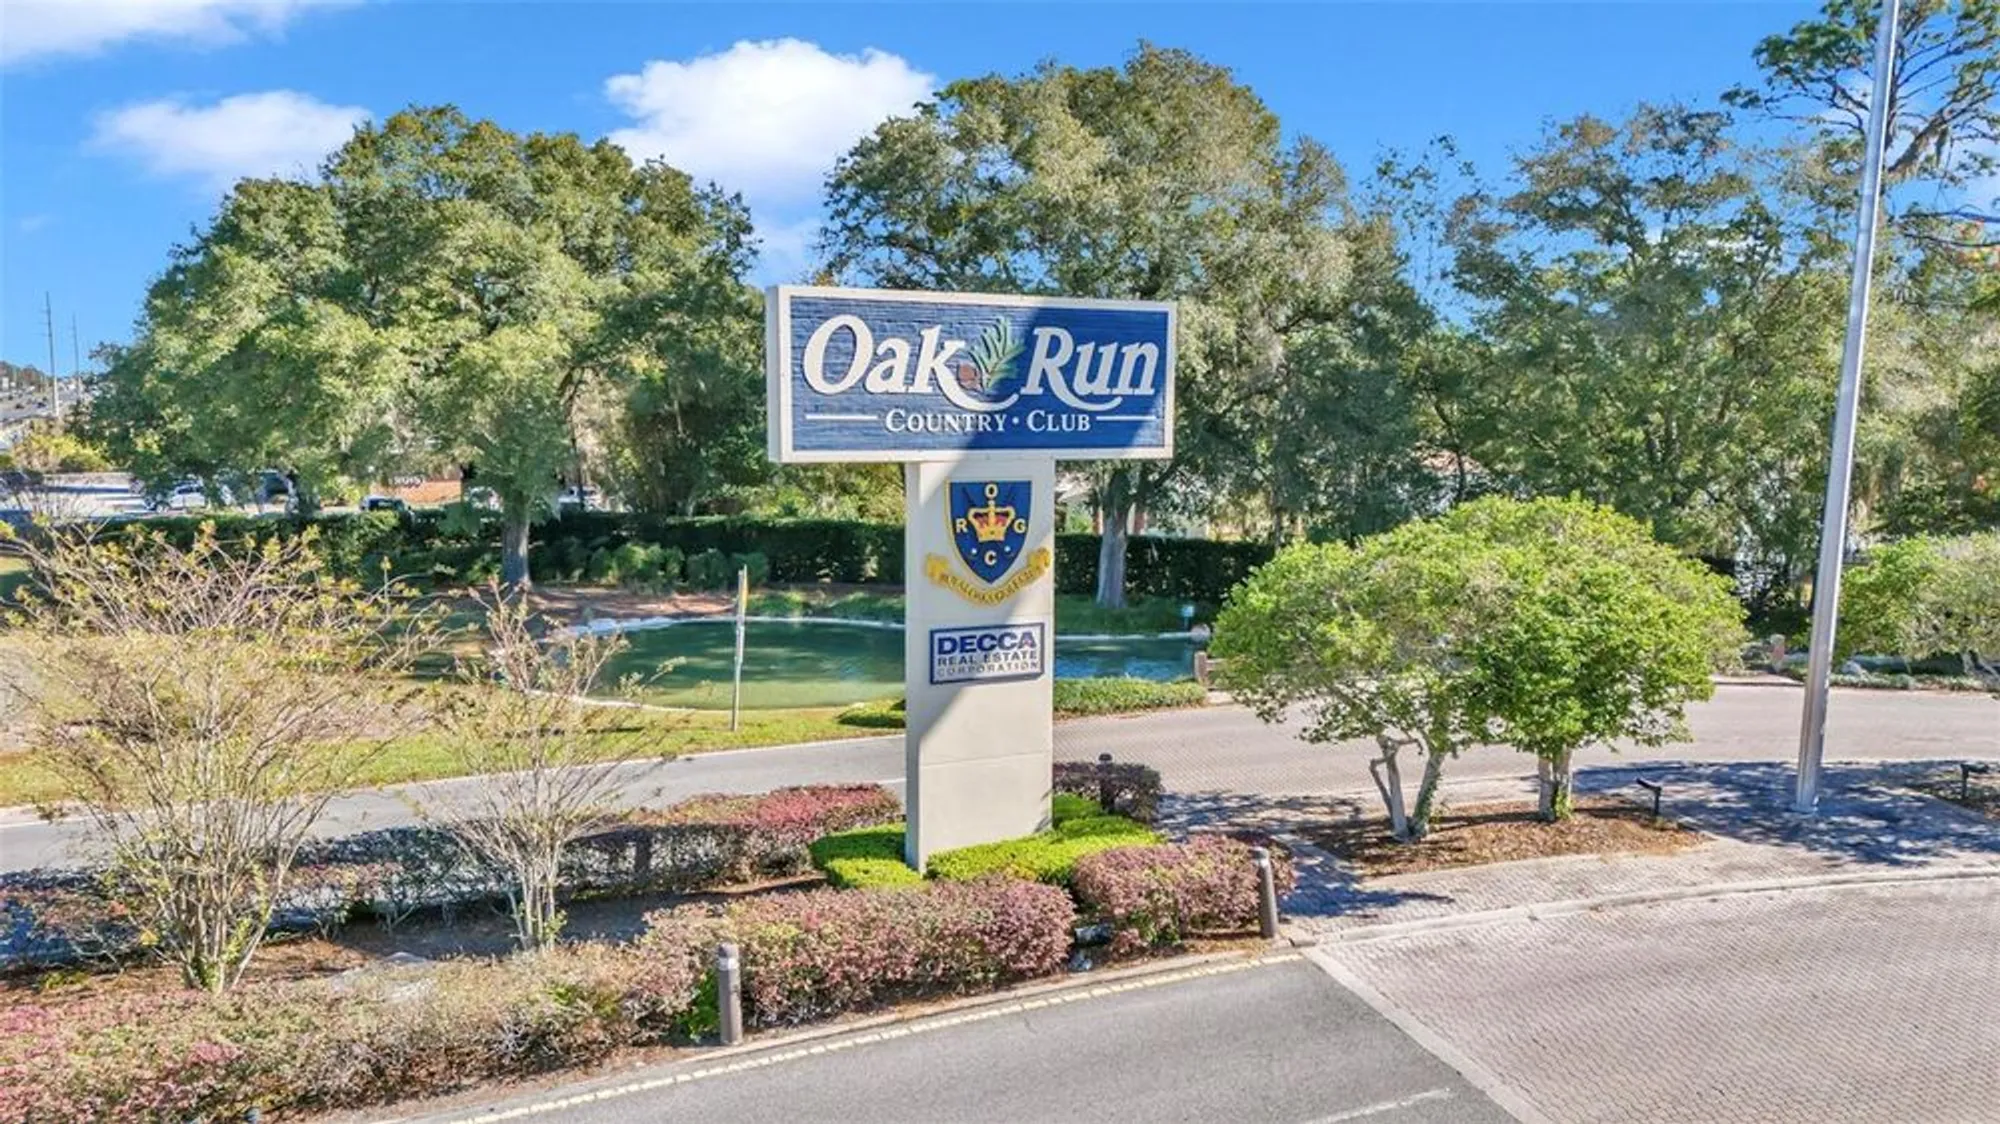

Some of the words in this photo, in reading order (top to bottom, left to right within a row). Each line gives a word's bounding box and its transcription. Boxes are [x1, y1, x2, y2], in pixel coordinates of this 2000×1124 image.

[803, 314, 1019, 411] Oak
[1020, 326, 1160, 411] Run
[886, 408, 1007, 432] COUNTRY
[1027, 409, 1092, 432] CLUB
[984, 483, 999, 498] O
[955, 518, 968, 533] R
[1013, 518, 1027, 533] G
[984, 550, 997, 566] C
[937, 631, 1037, 655] DECCA
[938, 655, 977, 666] REAL
[983, 650, 1037, 663] ESTATE
[937, 661, 1039, 677] CORPORATION
